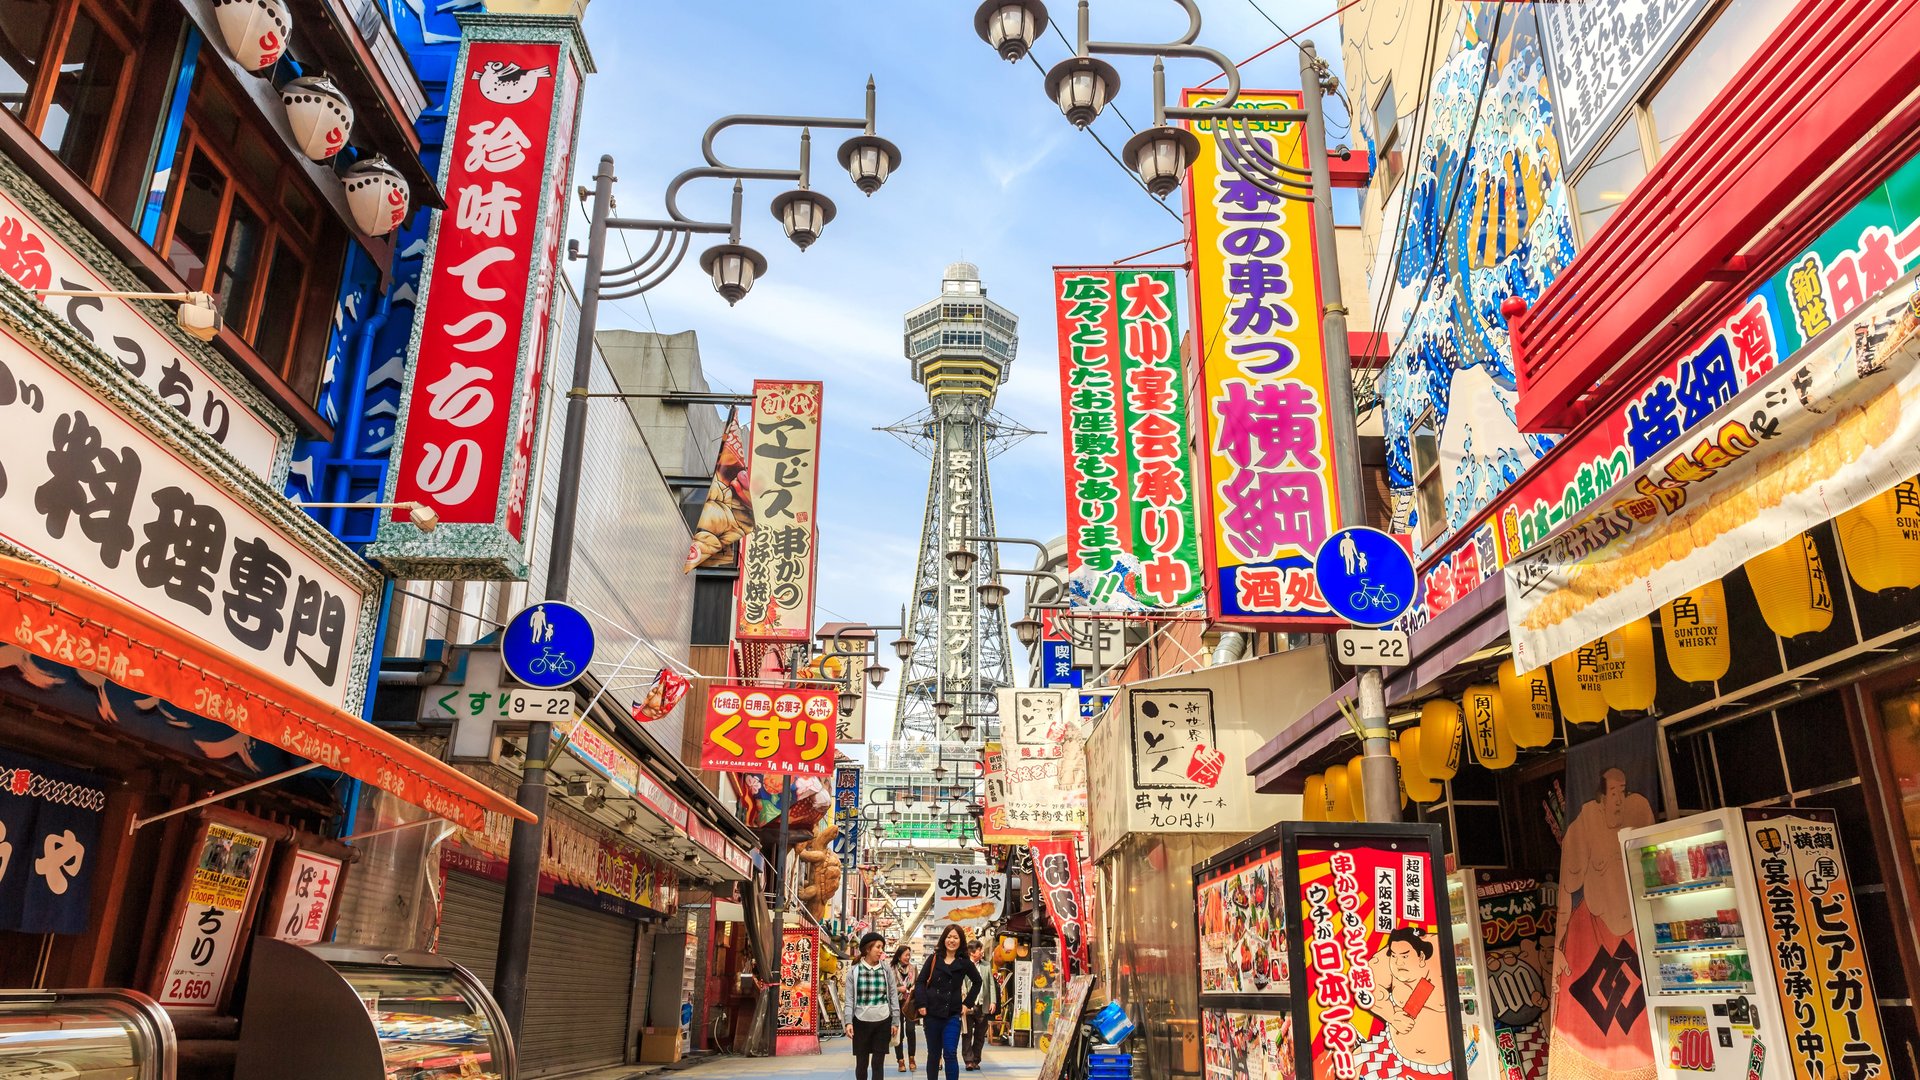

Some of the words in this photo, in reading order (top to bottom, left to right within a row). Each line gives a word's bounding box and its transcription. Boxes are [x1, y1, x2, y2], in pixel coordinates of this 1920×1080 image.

[1217, 135, 1294, 375] 日本一の串かつ
[415, 116, 532, 505] 珍味てっちり
[60, 277, 231, 445] てっちり
[1122, 273, 1191, 605] 大小宴会承り中
[1217, 382, 1328, 559] 横綱
[744, 525, 772, 623] お好み焼き
[773, 525, 811, 608] 串かつ
[1671, 595, 1700, 628] 角
[1673, 626, 1719, 639] SUNTORY
[14, 614, 145, 683] ふぐなら日本一
[1054, 645, 1070, 677] 喫茶
[1677, 637, 1718, 649] WHISKY
[194, 686, 248, 729] づぼらや
[744, 700, 771, 712] 日用品
[775, 701, 802, 714] お菓子
[1530, 678, 1548, 703] 角
[709, 714, 829, 761] くすり
[1184, 701, 1204, 742] 新世界
[1475, 696, 1495, 758] 角ハイボール
[280, 725, 351, 769] ふぐなら日本一
[1135, 791, 1199, 813] 串カツ
[1792, 831, 1835, 851] 横綱
[937, 867, 1002, 902] 味自慢
[1377, 870, 1394, 931] 大阪名物
[1405, 857, 1421, 918] 超絶美味
[1332, 853, 1374, 1006] 串かつもどて焼も
[168, 977, 212, 1001] 2,650
[1669, 1015, 1691, 1026] HAPPY
[1692, 1015, 1708, 1026] PRIC
[1678, 1028, 1716, 1072] 100
